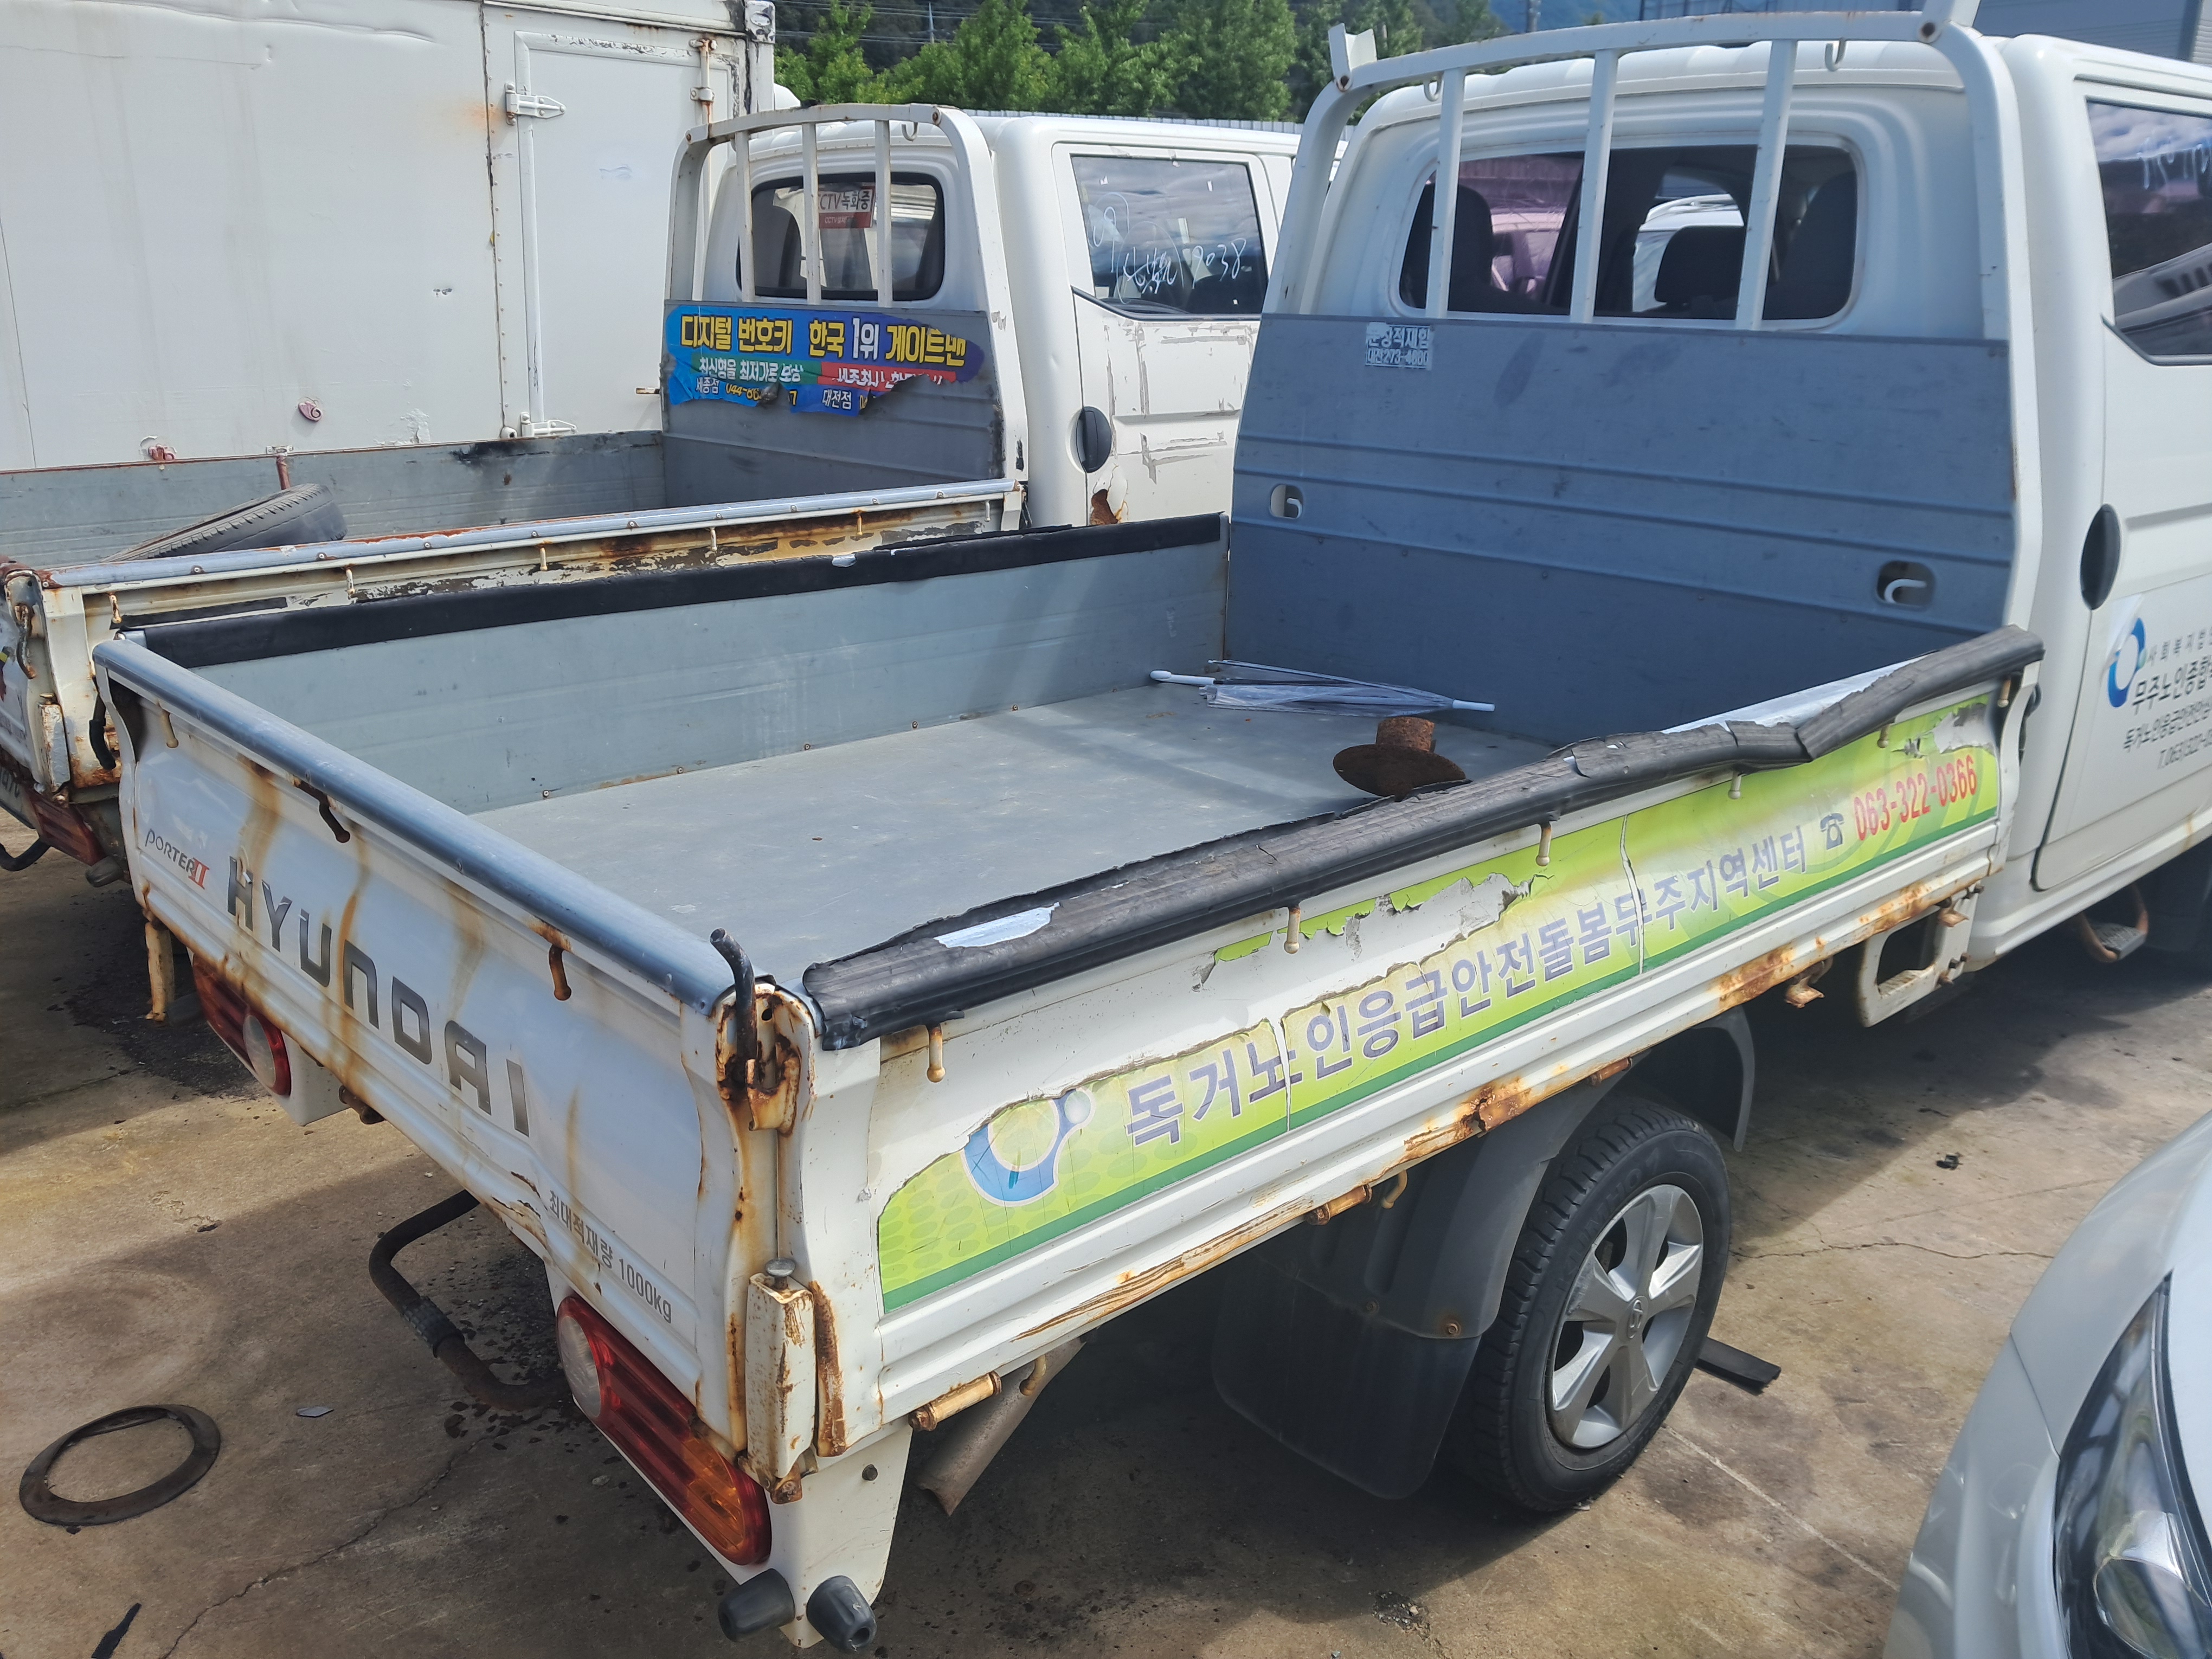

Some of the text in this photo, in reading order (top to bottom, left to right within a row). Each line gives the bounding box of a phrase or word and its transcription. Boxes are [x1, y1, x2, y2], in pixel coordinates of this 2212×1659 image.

[818, 190, 870, 210] CTV녹화중
[681, 316, 732, 350] 디지털
[738, 317, 793, 354] 번호키
[809, 319, 845, 358] 한국
[852, 317, 879, 361] 1위
[739, 358, 779, 383] 최저가로
[822, 389, 852, 410] 대전점
[1853, 754, 1978, 841] 063-322-0366
[144, 828, 196, 877] PORTER
[227, 856, 530, 1137] HYUNDAI
[549, 1189, 672, 1324] 최대적재량 1000kg
